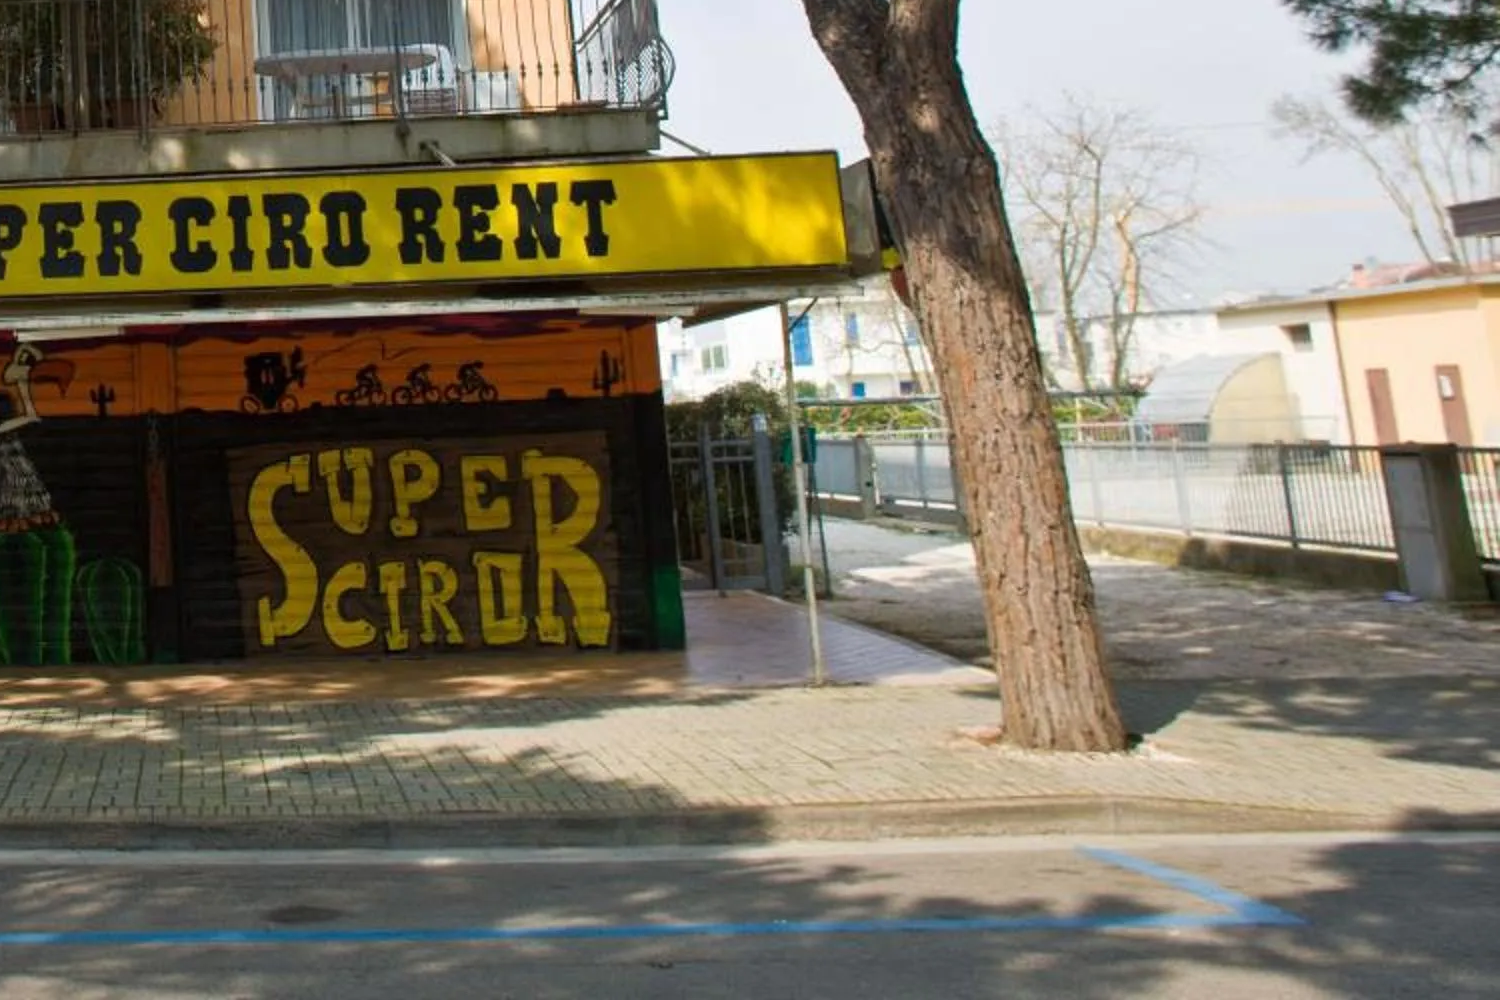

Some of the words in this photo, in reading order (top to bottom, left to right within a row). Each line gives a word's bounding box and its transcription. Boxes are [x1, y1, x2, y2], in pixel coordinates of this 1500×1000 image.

[167, 190, 372, 273] CIRO
[395, 179, 618, 265] RENT
[248, 447, 611, 647] SUPER
